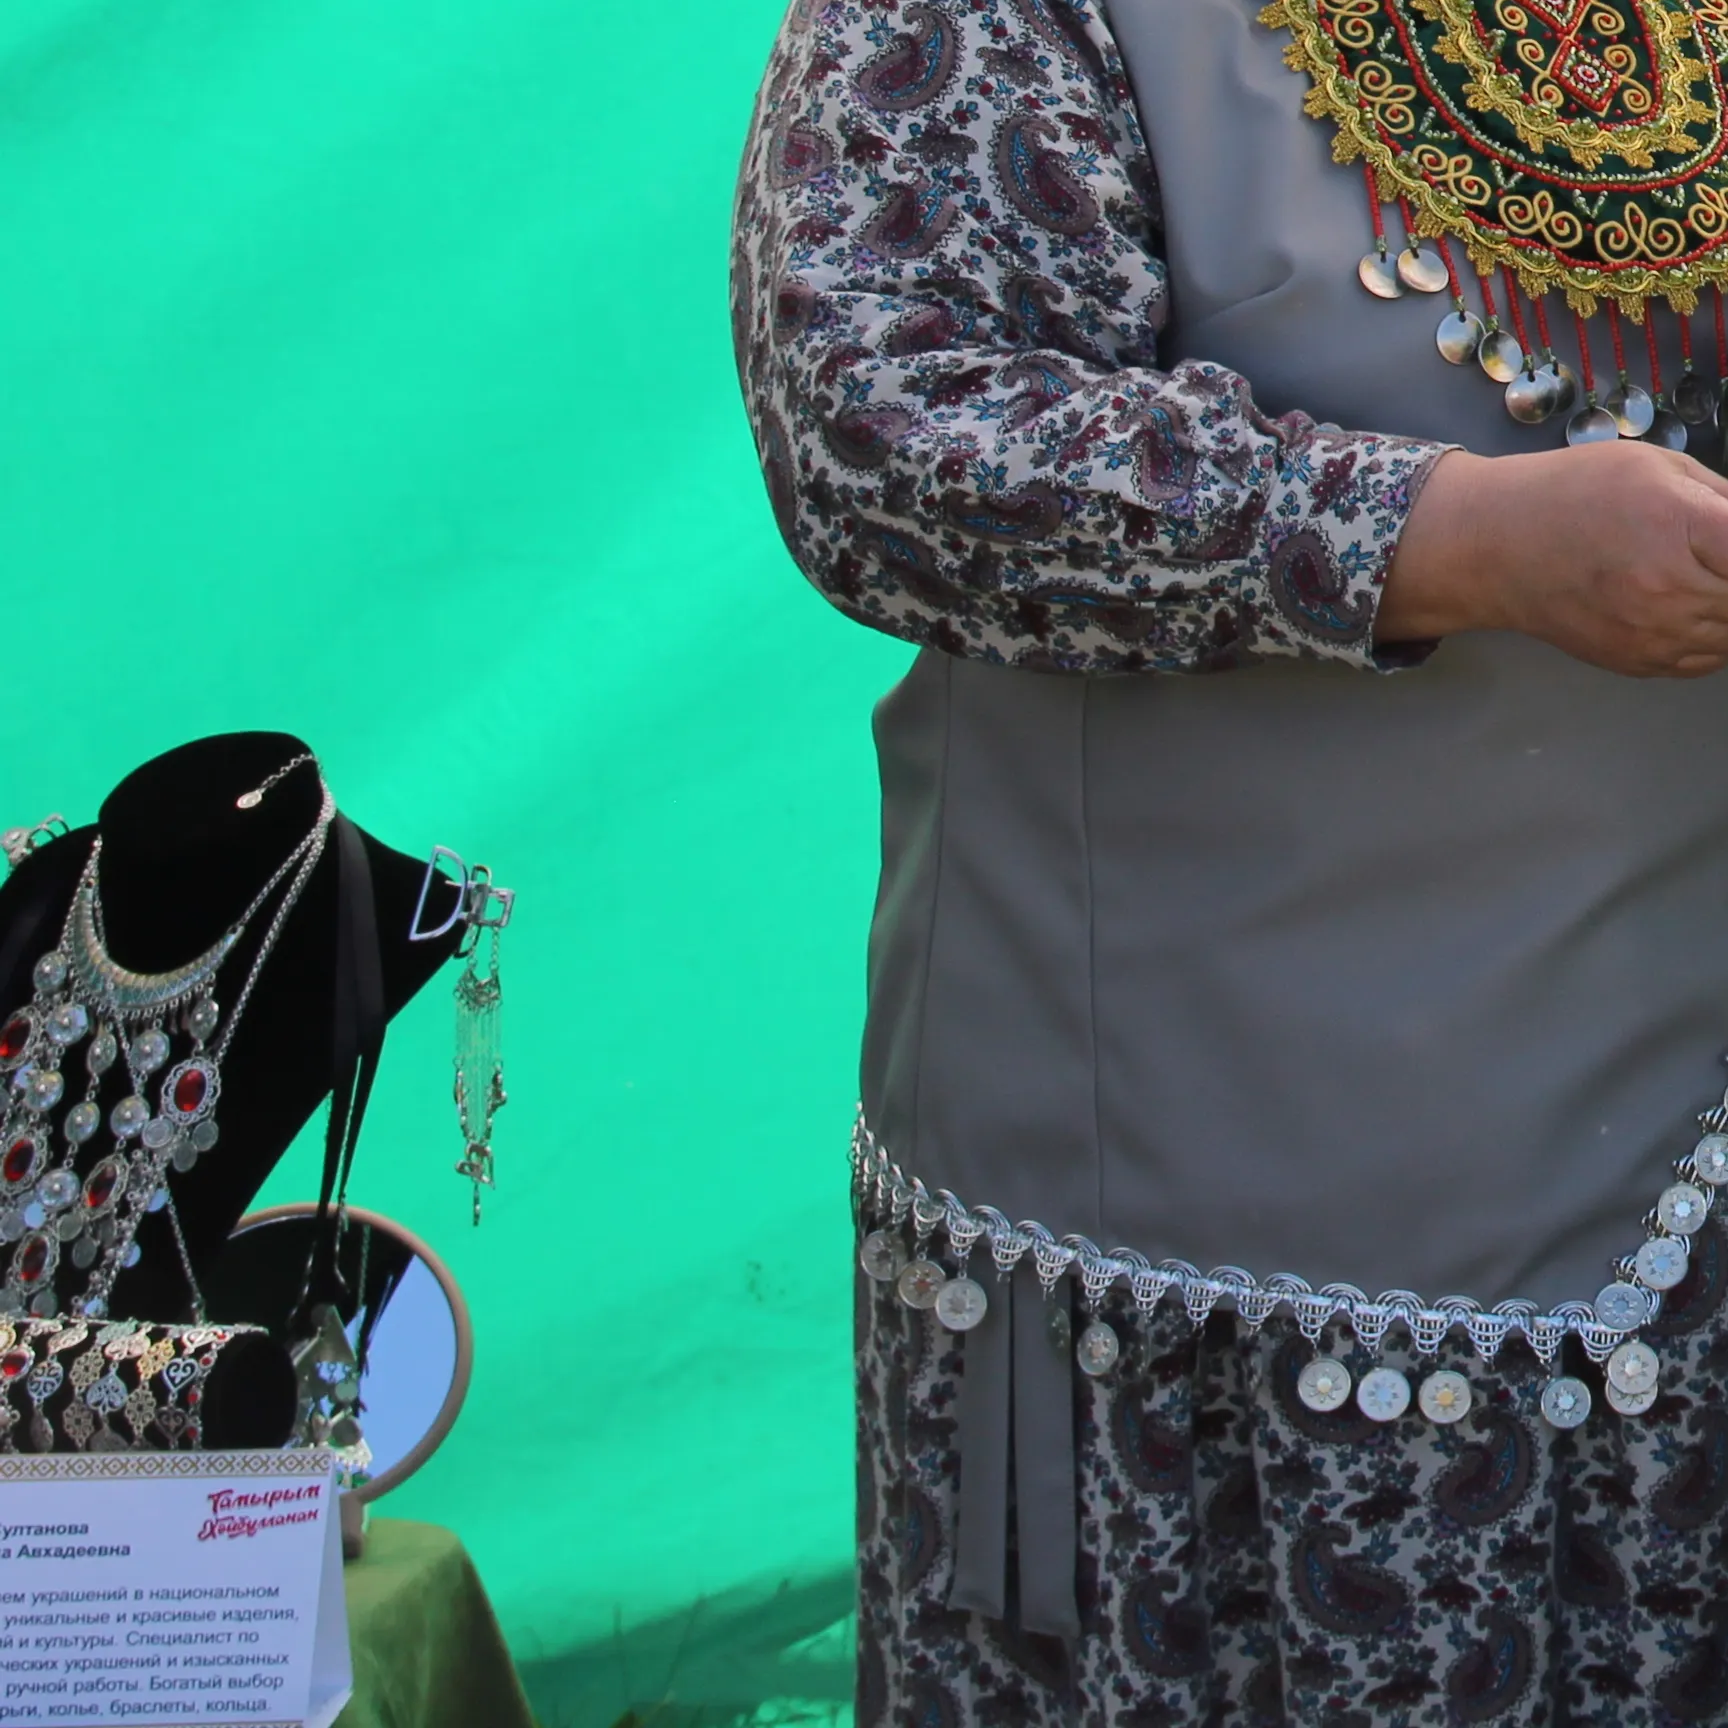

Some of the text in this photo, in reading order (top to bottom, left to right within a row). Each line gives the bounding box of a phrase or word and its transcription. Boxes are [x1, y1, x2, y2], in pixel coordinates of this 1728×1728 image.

[207, 1484, 321, 1515] Тамырым
[0, 1523, 89, 1541] ултанова
[16, 1544, 131, 1560] Авхадеевна
[31, 1589, 128, 1607] украшений
[134, 1589, 144, 1601] в
[149, 1586, 280, 1603] национальном
[4, 1607, 299, 1631] уникальные и красивые изделия,
[19, 1637, 30, 1649] и
[35, 1635, 118, 1652] культуры.
[126, 1630, 232, 1647] Специалист
[238, 1632, 260, 1644] по
[65, 1656, 161, 1674] украшений
[167, 1656, 178, 1668] и
[183, 1653, 289, 1667] изысканных
[6, 1672, 284, 1699] ручной работы. Богатый выбор
[48, 1703, 103, 1717] колье,
[110, 1699, 200, 1718] браслеты,
[206, 1699, 271, 1714] кольца.
